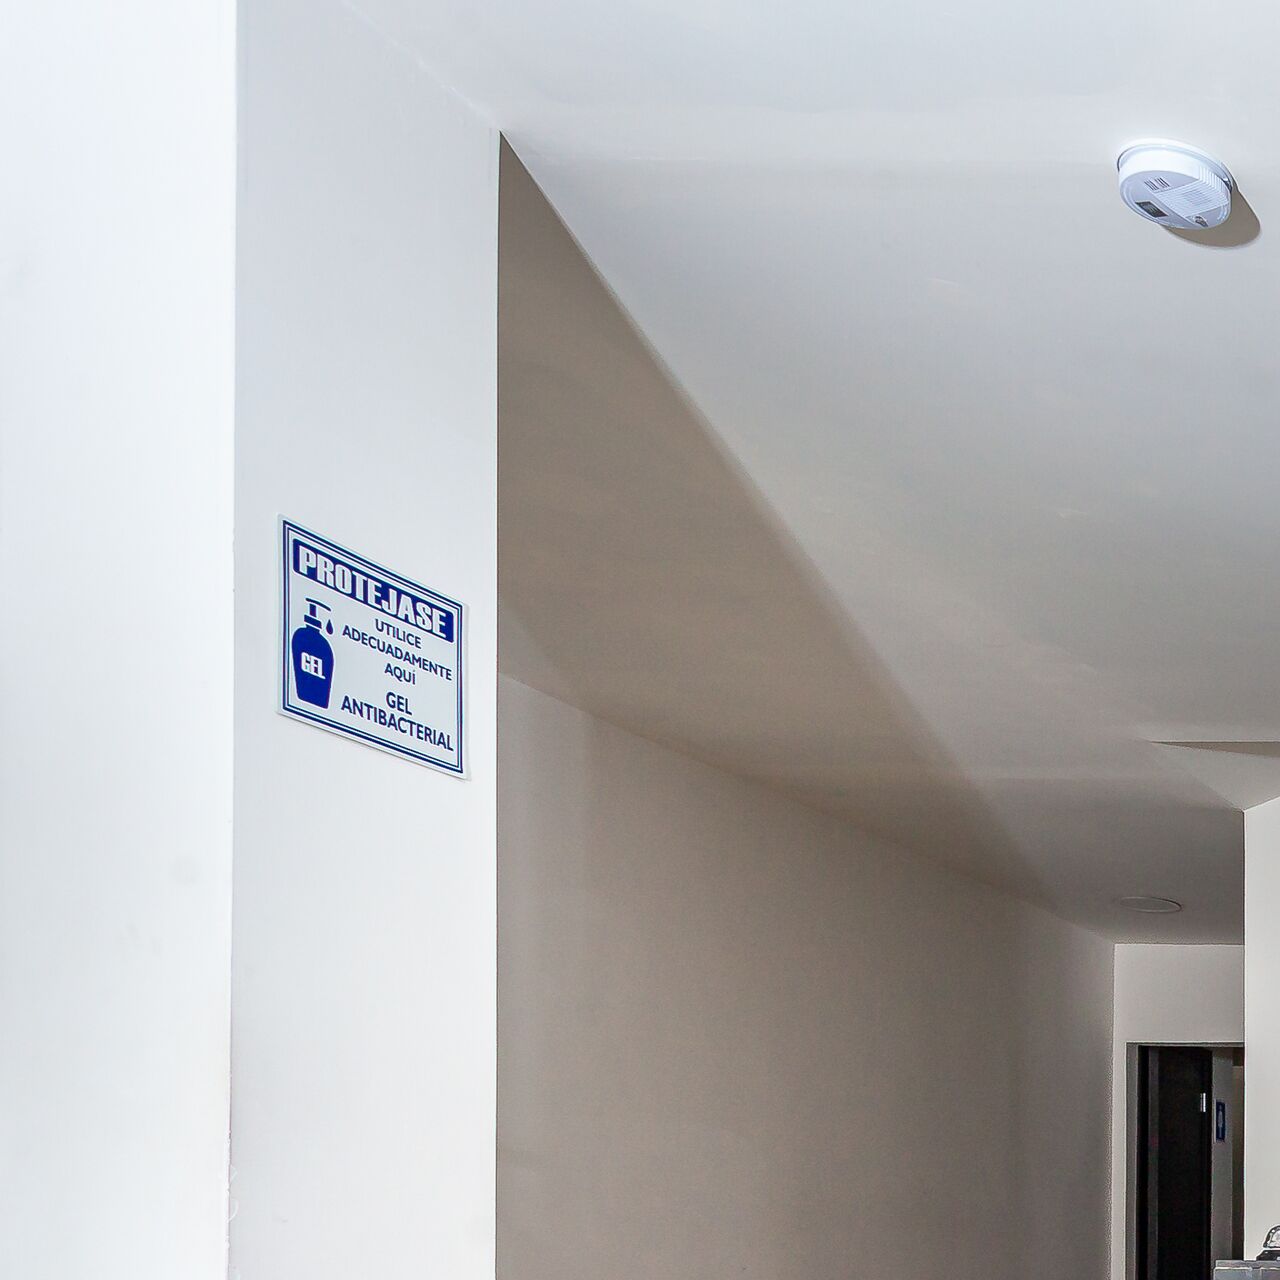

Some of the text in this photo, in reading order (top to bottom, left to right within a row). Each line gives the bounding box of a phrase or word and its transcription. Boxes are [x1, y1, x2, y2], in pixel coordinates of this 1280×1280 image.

[298, 543, 448, 638] PROTEJASE
[341, 624, 453, 682] ADECUADAMENTE
[374, 617, 422, 650] UTILICE
[300, 650, 327, 680] GEL
[340, 694, 454, 752] ANTIBACTERIAL
[385, 690, 413, 716] GEL
